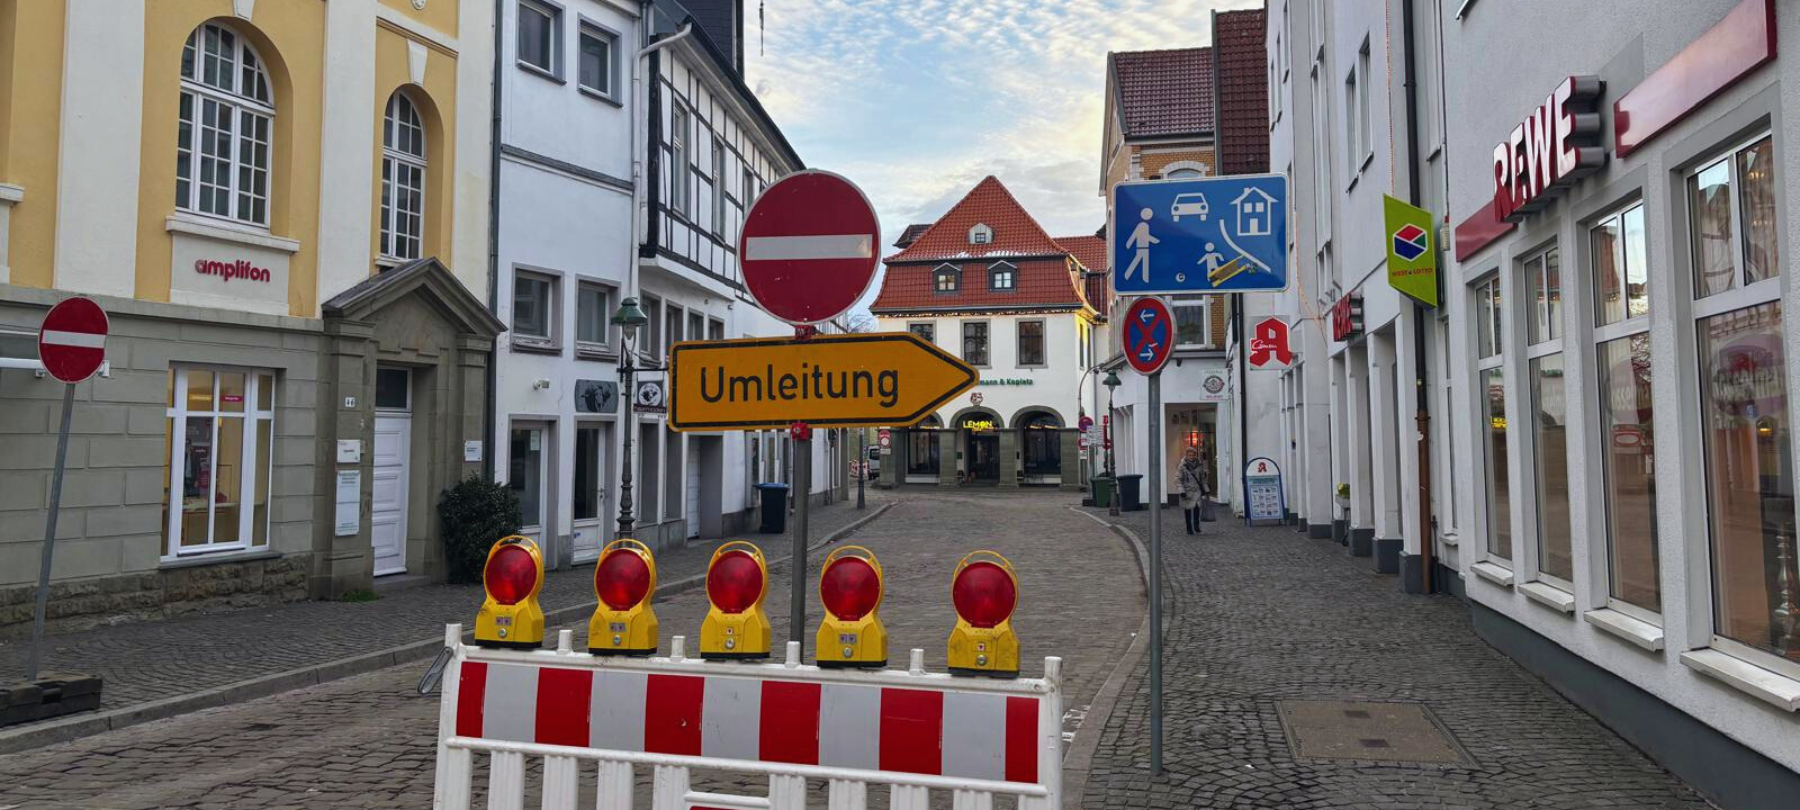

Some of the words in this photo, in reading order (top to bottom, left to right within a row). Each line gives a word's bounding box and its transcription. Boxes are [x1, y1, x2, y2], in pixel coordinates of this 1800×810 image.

[1493, 76, 1577, 222] REWE
[195, 259, 271, 283] amplifon
[700, 363, 898, 408] Umleitung
[963, 420, 993, 429] LEMON
